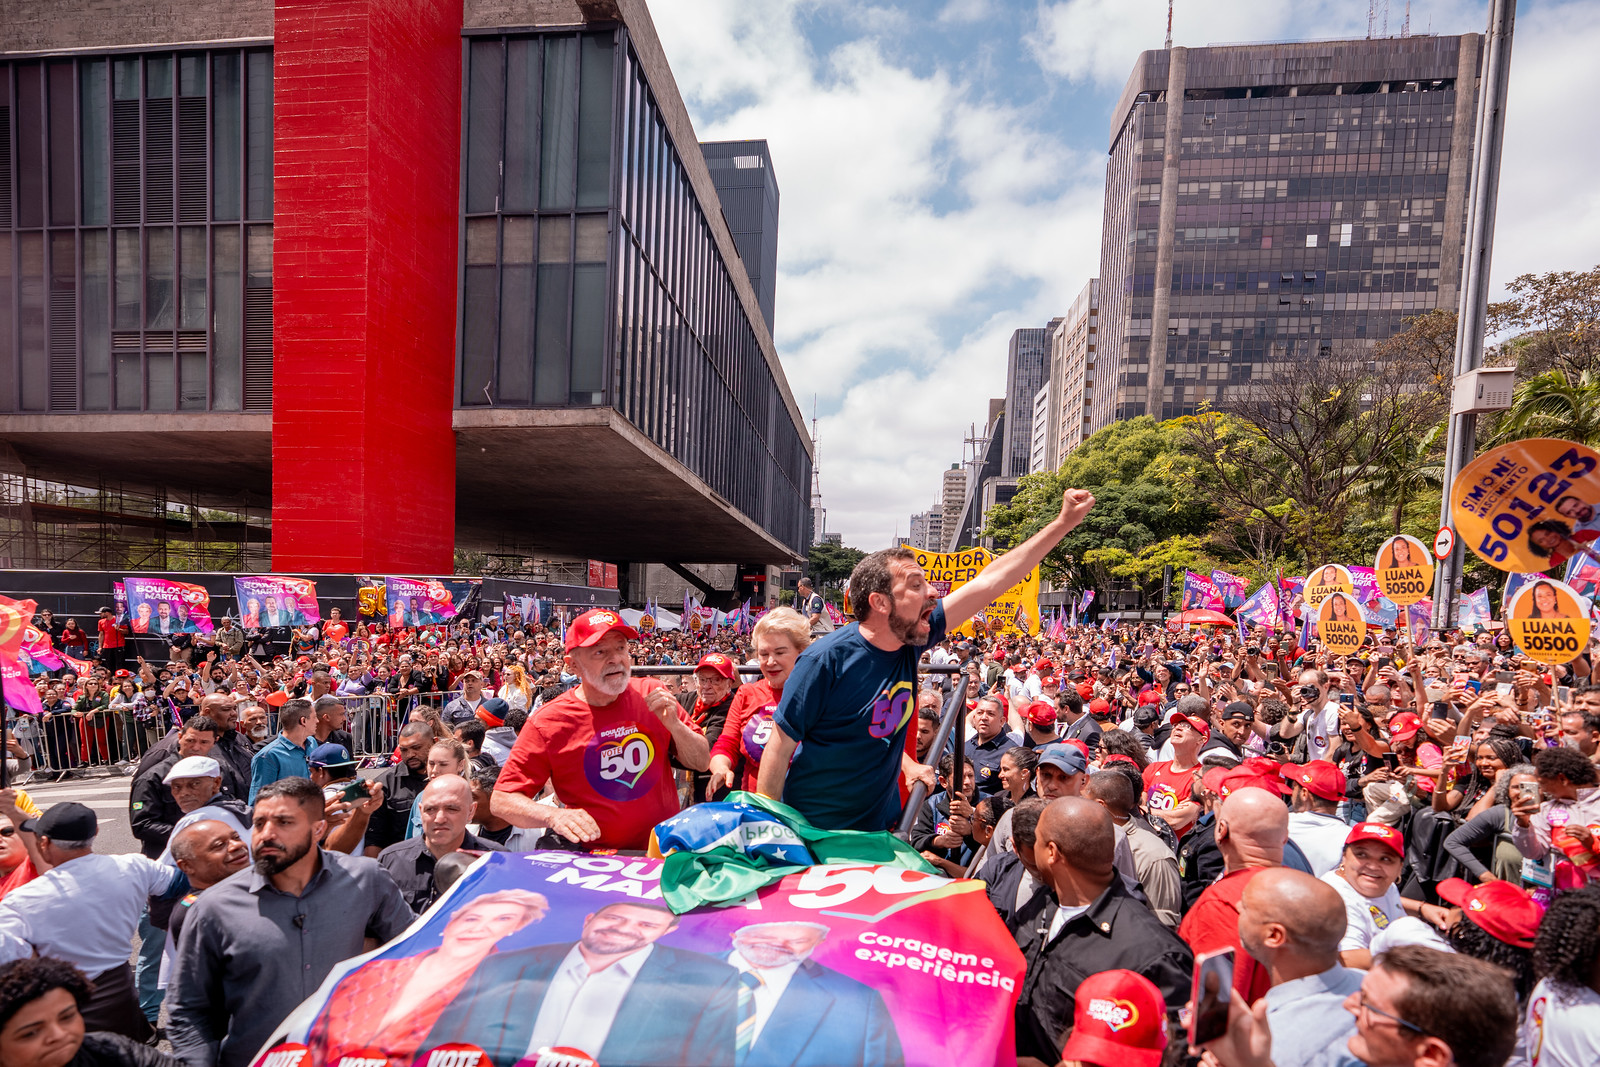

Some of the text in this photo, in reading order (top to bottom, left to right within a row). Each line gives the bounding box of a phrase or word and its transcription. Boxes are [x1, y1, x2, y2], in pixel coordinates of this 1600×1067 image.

[1461, 456, 1517, 512] SIMONE
[1478, 466, 1528, 519] NASCIMENTO
[1478, 447, 1597, 562] 50123
[917, 554, 928, 567] O
[932, 551, 984, 568] AMOR
[923, 568, 977, 582] ENCER
[1385, 569, 1423, 581] LUANA
[136, 585, 180, 594] BOULOS
[251, 587, 284, 595] MARTA
[392, 583, 428, 591] BOULOS
[1311, 586, 1344, 595] LUANA
[1386, 581, 1425, 594] 50500
[145, 592, 179, 601] MARTA
[181, 589, 204, 603] 50
[1325, 622, 1358, 633] LUANA
[1522, 621, 1576, 634] LUANA
[1326, 634, 1359, 646] 50500
[1524, 636, 1579, 651] 50500
[868, 691, 911, 738] 50
[601, 725, 625, 738] BOULOS
[615, 727, 638, 738] MARTA
[752, 721, 772, 744] 5
[602, 746, 622, 758] VOTE
[600, 740, 649, 780] 50
[1150, 791, 1174, 811] 50
[523, 851, 660, 881] BOU
[531, 860, 563, 870] VICE
[788, 864, 957, 909] 50
[858, 931, 994, 969] Coragem e
[854, 947, 1015, 993] experiência
[261, 1050, 308, 1067] VOTE
[425, 1050, 484, 1067] VOTE
